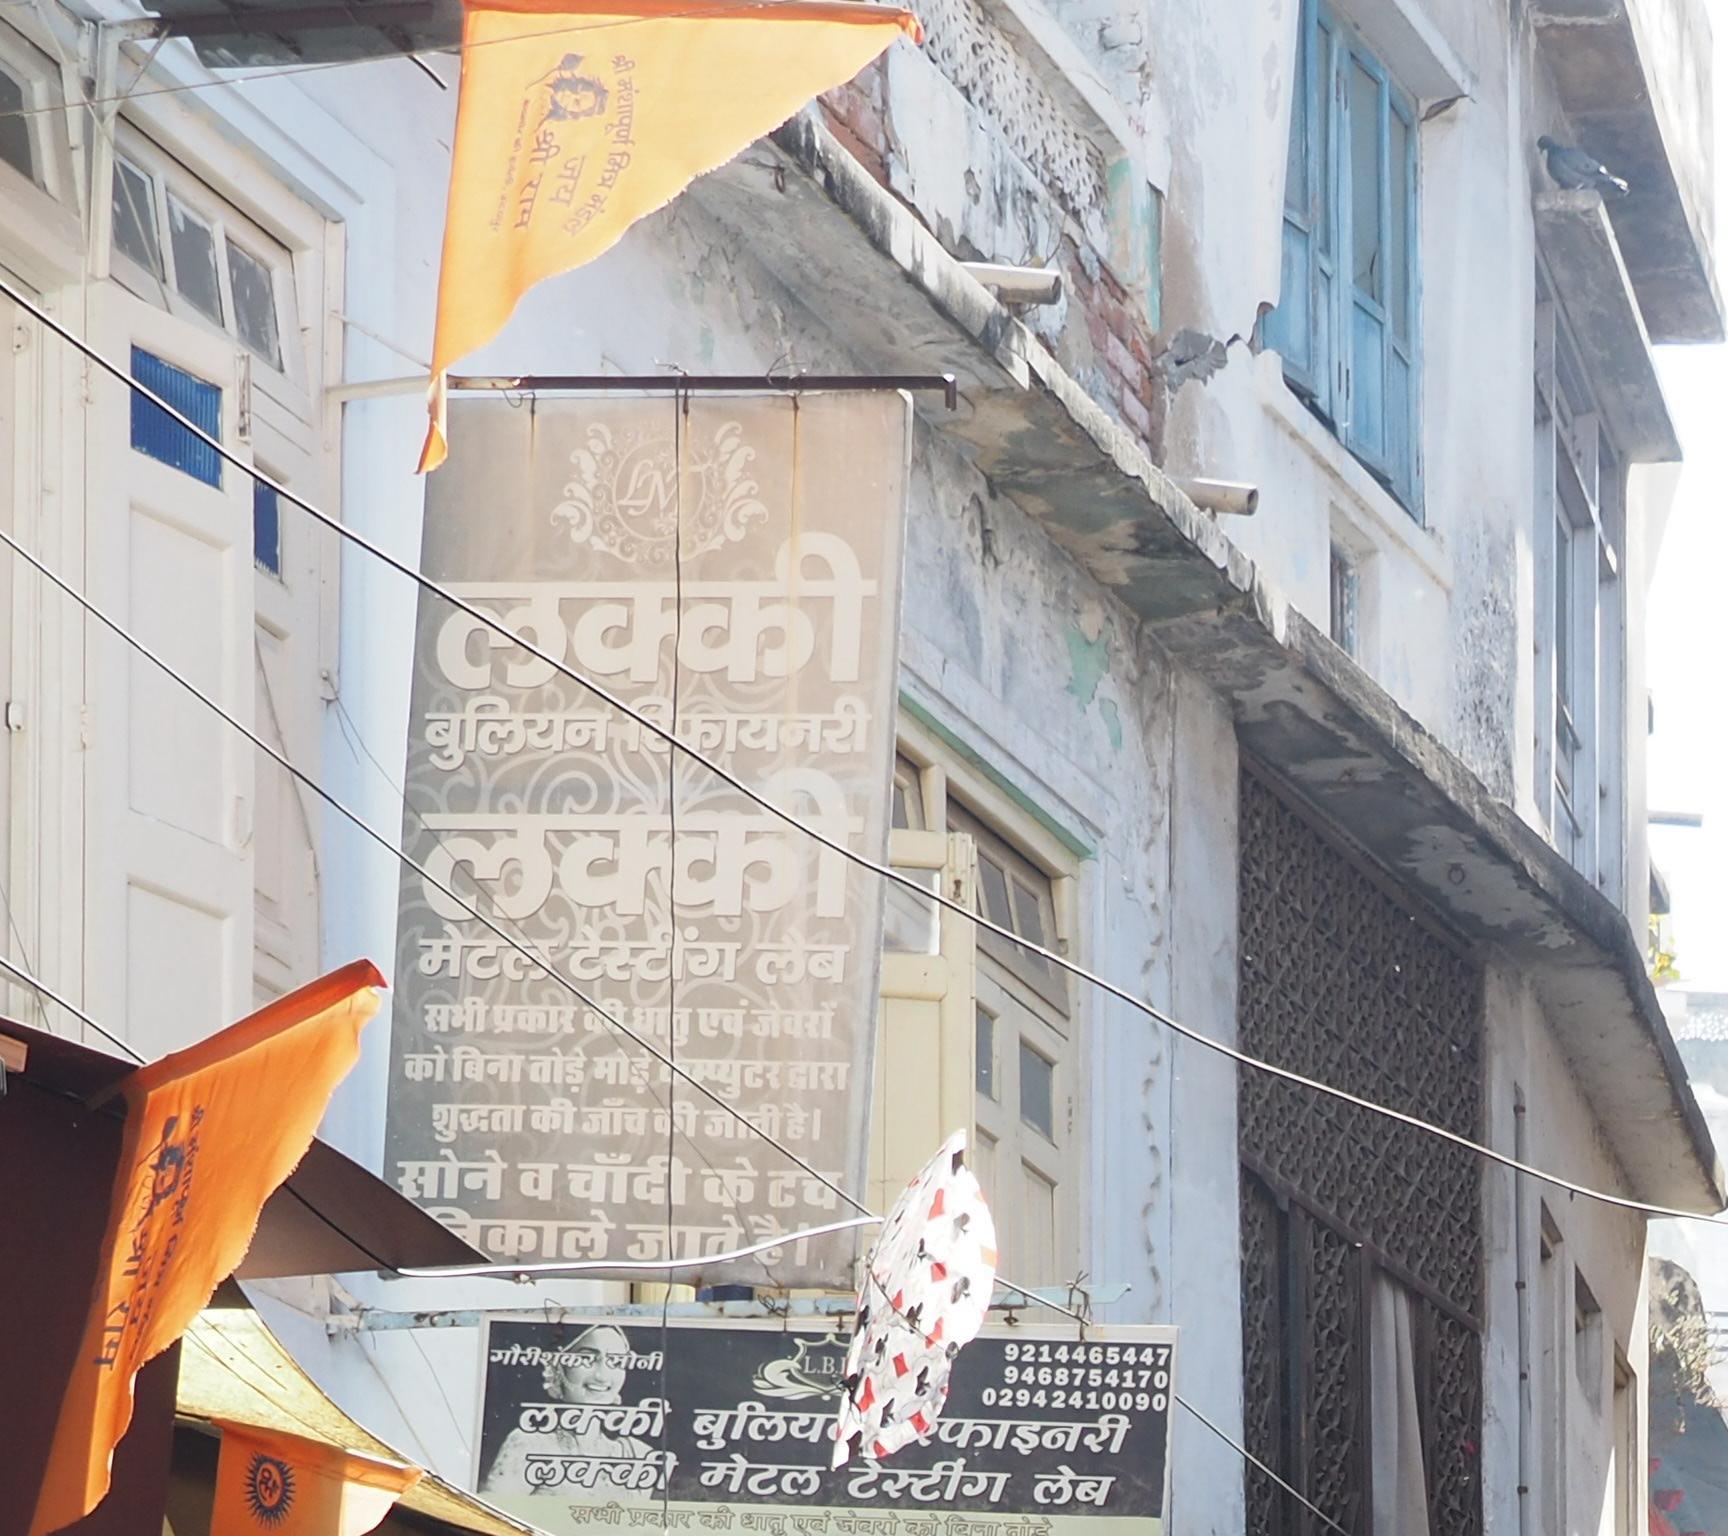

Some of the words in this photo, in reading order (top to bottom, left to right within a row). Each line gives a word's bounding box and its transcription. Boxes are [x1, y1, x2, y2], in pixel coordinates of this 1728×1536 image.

[436, 531, 877, 690] लक्की
[424, 696, 613, 771] बुलियन
[627, 695, 872, 754] रिफायनरी
[420, 768, 865, 921] लक्की
[418, 926, 560, 981] मेटल
[424, 998, 491, 1034] सभी
[493, 1003, 577, 1034] प्रकार
[634, 1005, 693, 1046] धातु
[698, 998, 749, 1039] एवं
[403, 1045, 454, 1081] को
[453, 1045, 525, 1084] बिना
[530, 1098, 577, 1135] की
[582, 1097, 650, 1136] जाँच
[653, 1101, 702, 1137] की
[705, 1103, 782, 1140] जाती
[396, 1151, 508, 1199] सोने
[517, 1162, 561, 1201] व
[566, 1152, 692, 1206] चाँदी
[700, 1157, 760, 1208] के
[626, 1214, 747, 1263] जाते
[603, 1349, 664, 1372] सोनी
[1004, 1343, 1170, 1366] 9214465447
[1004, 1366, 1169, 1388] 9468754170
[519, 1398, 672, 1438] लक्की
[982, 1388, 1167, 1412] 02942410090
[525, 1450, 678, 1491] लक्की
[700, 1453, 826, 1496] मेटल
[569, 1501, 626, 1526] सभी
[698, 1505, 735, 1530] की
